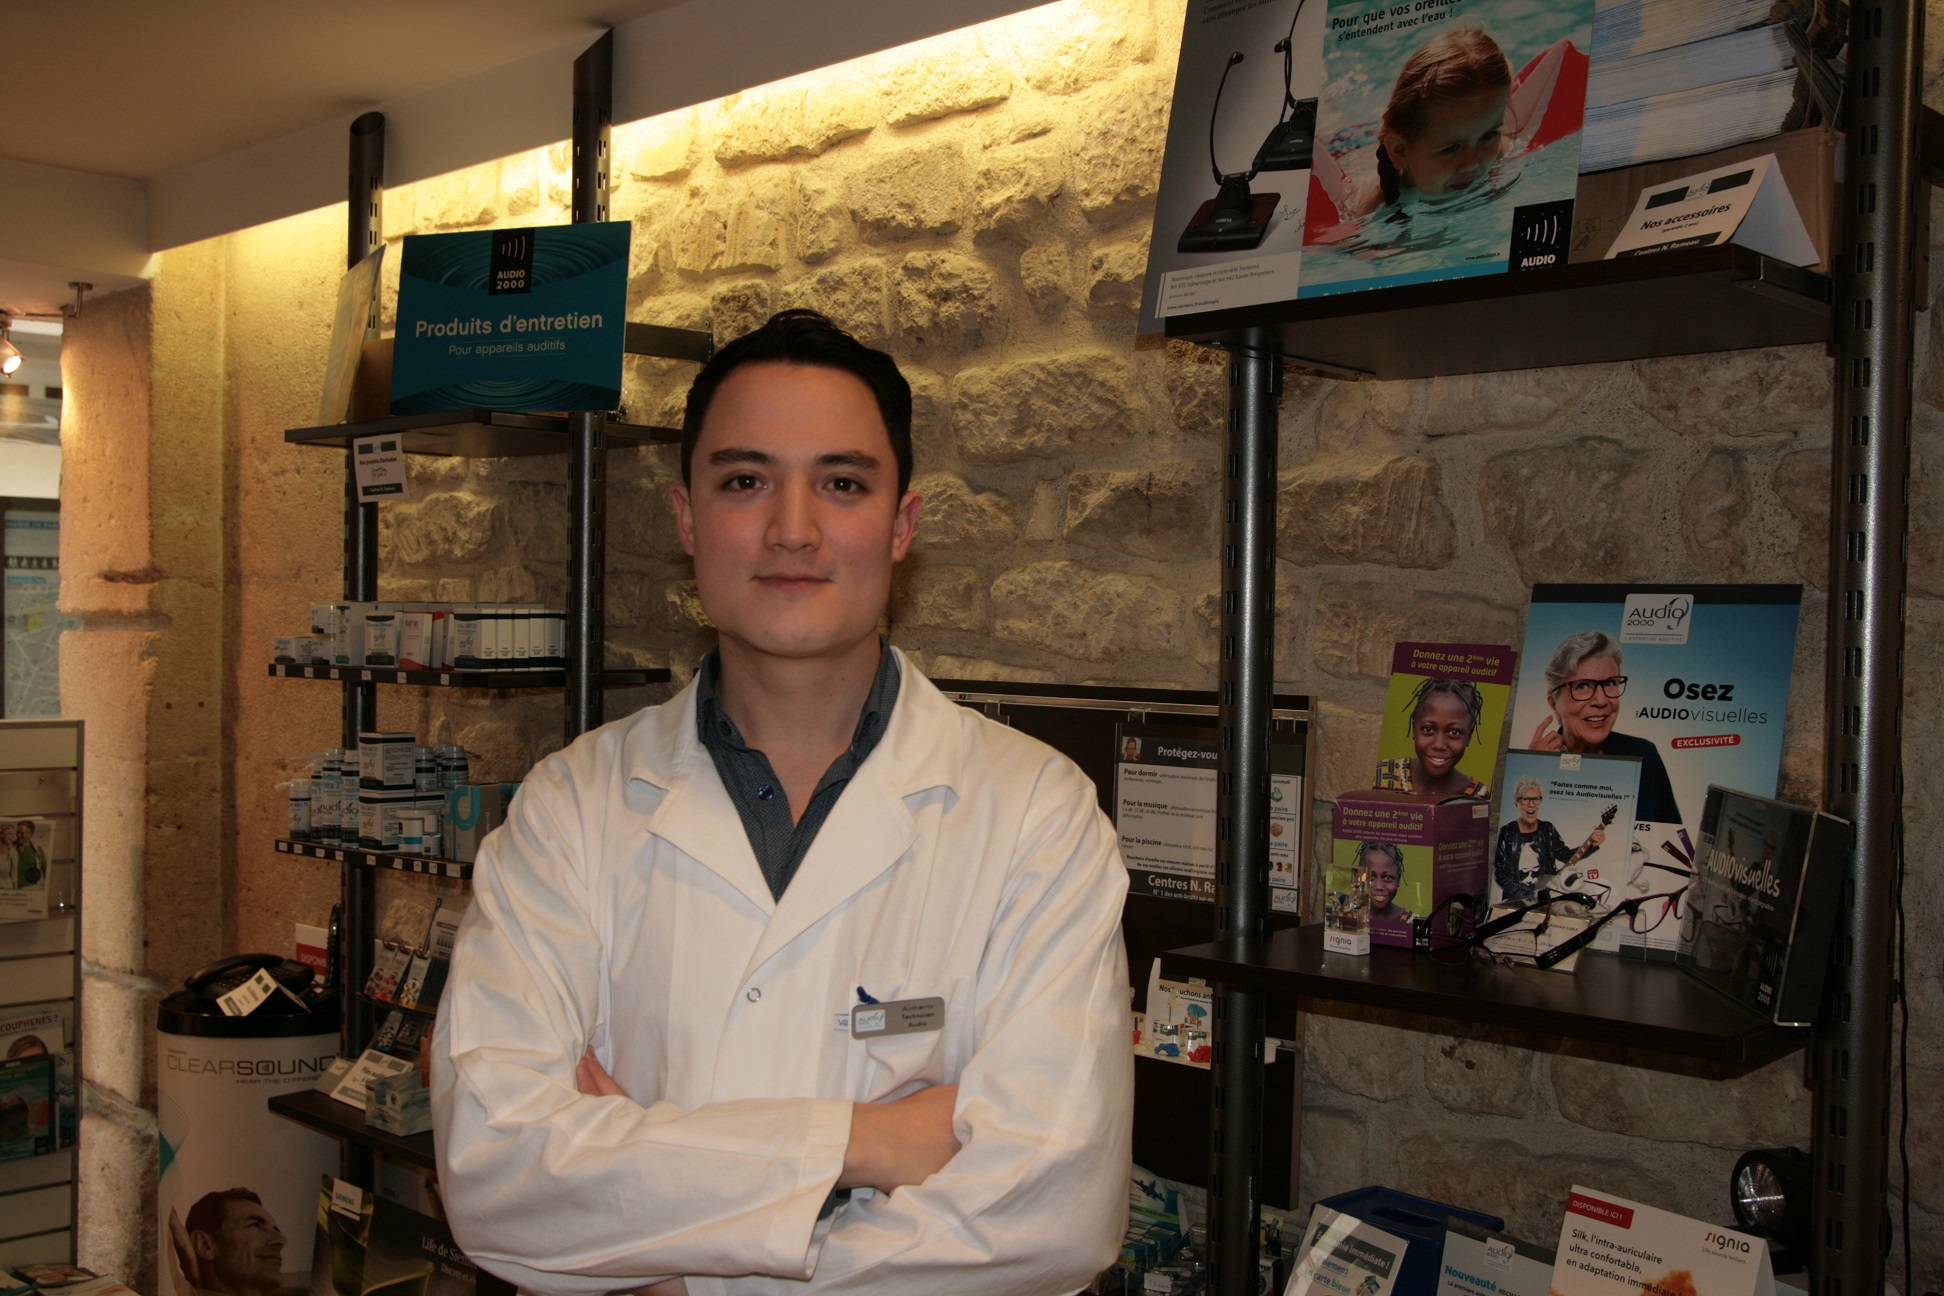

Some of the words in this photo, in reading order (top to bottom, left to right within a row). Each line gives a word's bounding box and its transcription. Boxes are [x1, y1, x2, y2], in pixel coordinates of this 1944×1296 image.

[1331, 17, 1359, 31] Pour
[1362, 9, 1386, 25] que
[1389, 4, 1411, 17] vos
[1414, 0, 1463, 12] oreille
[1337, 21, 1394, 42] s'entendent
[1396, 16, 1419, 29] avec
[1421, 11, 1446, 24] l'eau
[1640, 218, 1664, 231] Nos
[1663, 203, 1732, 226] accessoires
[1669, 238, 1701, 250] Rameau
[1520, 254, 1557, 268] AUDIO
[496, 269, 526, 281] AUDIO
[495, 279, 526, 290] 2000
[415, 316, 493, 338] Produits
[499, 312, 604, 334] d'entretien
[448, 344, 473, 356] Pour
[475, 340, 524, 359] appareils
[526, 338, 566, 353] auditifs
[1626, 619, 1655, 627] 2000
[1412, 649, 1446, 661] Donnez
[1447, 654, 1465, 662] une
[1486, 657, 1501, 667] vie
[1411, 660, 1416, 668] à
[1417, 662, 1438, 670] votre
[1438, 664, 1471, 674] appareil
[1471, 668, 1498, 677] auditif
[1663, 677, 1735, 701] Osez
[1639, 707, 1768, 724] AUDIOvisuelles
[1676, 734, 1735, 747] EXCLUSIVITÉ
[1157, 746, 1218, 761] Protégez-vou
[1124, 768, 1138, 776] Pour
[1138, 769, 1158, 777] dormir
[1573, 783, 1599, 791] comme
[1599, 784, 1614, 792] moi,
[1575, 791, 1623, 801] Audiovisuelles
[1122, 798, 1137, 807] Pour
[1143, 801, 1168, 811] musique
[1342, 806, 1374, 818] Donnez
[1374, 809, 1391, 819] une
[1410, 812, 1424, 821] vie
[1342, 818, 1347, 826] à
[1348, 819, 1367, 828] votre
[1368, 820, 1398, 831] appareil
[1398, 822, 1424, 831] auditif
[1121, 835, 1135, 843] Pour
[1141, 838, 1162, 847] piscine
[1707, 849, 1781, 898] AUDIOvisuelles
[1148, 874, 1188, 890] Centres
[1190, 879, 1202, 893] N.
[1204, 881, 1216, 893] Ra
[1158, 984, 1171, 993] Nos
[1172, 987, 1201, 998] uchons
[1757, 991, 1771, 1006] 2000
[166, 1054, 337, 1076] CLEARSOUND
[1572, 1199, 1610, 1217] DISPONIBLE
[1609, 1211, 1620, 1220] ICI
[1571, 1228, 1589, 1243] Silk,
[1590, 1232, 1663, 1265] l'intra-auriculaire
[1704, 1231, 1751, 1254] signia
[421, 1236, 437, 1253] Life
[437, 1243, 449, 1258] de
[449, 1247, 477, 1269] Sieme
[1349, 1245, 1386, 1267] immédiate
[1569, 1243, 1589, 1258] ultra
[1590, 1251, 1643, 1275] confortable,
[1313, 1272, 1332, 1285] carte
[1331, 1277, 1351, 1295] bleue
[1444, 1264, 1497, 1292] Nouveauté
[1566, 1257, 1577, 1267] en
[1578, 1261, 1626, 1284] adaptation
[1627, 1276, 1676, 1296] immédiate
[1453, 1283, 1475, 1295] première
